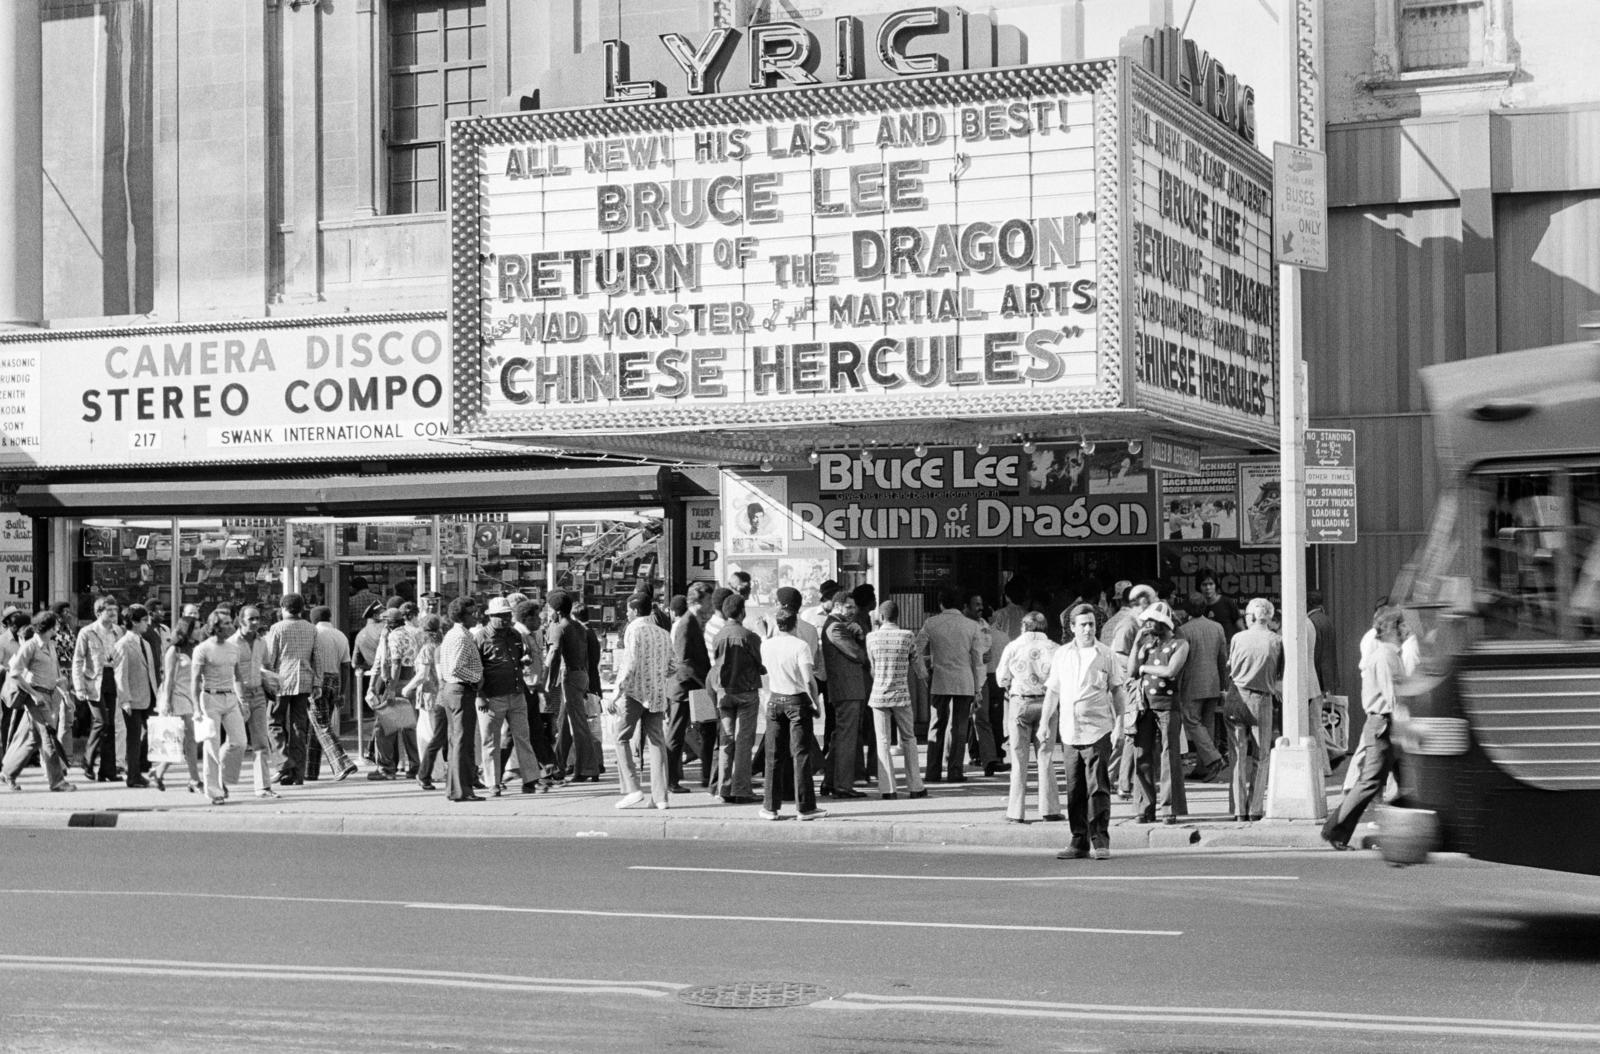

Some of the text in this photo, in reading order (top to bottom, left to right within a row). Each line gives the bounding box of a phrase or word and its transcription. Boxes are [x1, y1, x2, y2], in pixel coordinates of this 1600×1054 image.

[602, 6, 948, 103] LYRIC
[1175, 27, 1255, 146] LYRIC
[505, 99, 1068, 178] ALL NEW! HIS LAST AND BEST!
[596, 172, 783, 232] BRUCE
[812, 159, 928, 216] LEE
[1286, 186, 1315, 206] BUSES
[1159, 168, 1208, 239] BRUCE
[1212, 201, 1241, 256] LEE
[1298, 218, 1321, 235] ONLY
[713, 236, 758, 269] OF
[768, 250, 839, 289] THE
[519, 310, 587, 345] MAD
[598, 301, 753, 340] MONSTER
[828, 287, 987, 328] MARTIAL
[1000, 278, 1096, 317] ARTS
[104, 329, 442, 379] CAMERA DISCO
[0, 358, 36, 368] NASONIC
[82, 373, 442, 423] STEREO COMPO
[1, 406, 26, 415] KODAK
[3, 422, 24, 431] SONY
[133, 432, 157, 448] 217
[220, 427, 273, 445] SWANK
[284, 422, 404, 442] INTERNATIONAL
[1306, 432, 1352, 441] NO STANDING
[2, 436, 39, 447] & HOWELL
[820, 449, 1019, 491] Bruce Lee
[1162, 477, 1237, 486] BACK SNAPPING!
[1331, 473, 1350, 481] TIMES
[1186, 485, 1234, 493] BREAKING!
[1307, 488, 1353, 497] NO STANDING
[1306, 499, 1354, 507] EXCEPT TRUCKS
[692, 507, 715, 517] TRUST
[1312, 509, 1349, 517] LOADING &
[697, 520, 711, 528] THE
[792, 497, 1149, 541] Return of the Dragon
[1311, 519, 1350, 528] UNLOADING
[690, 531, 720, 540] LEADER
